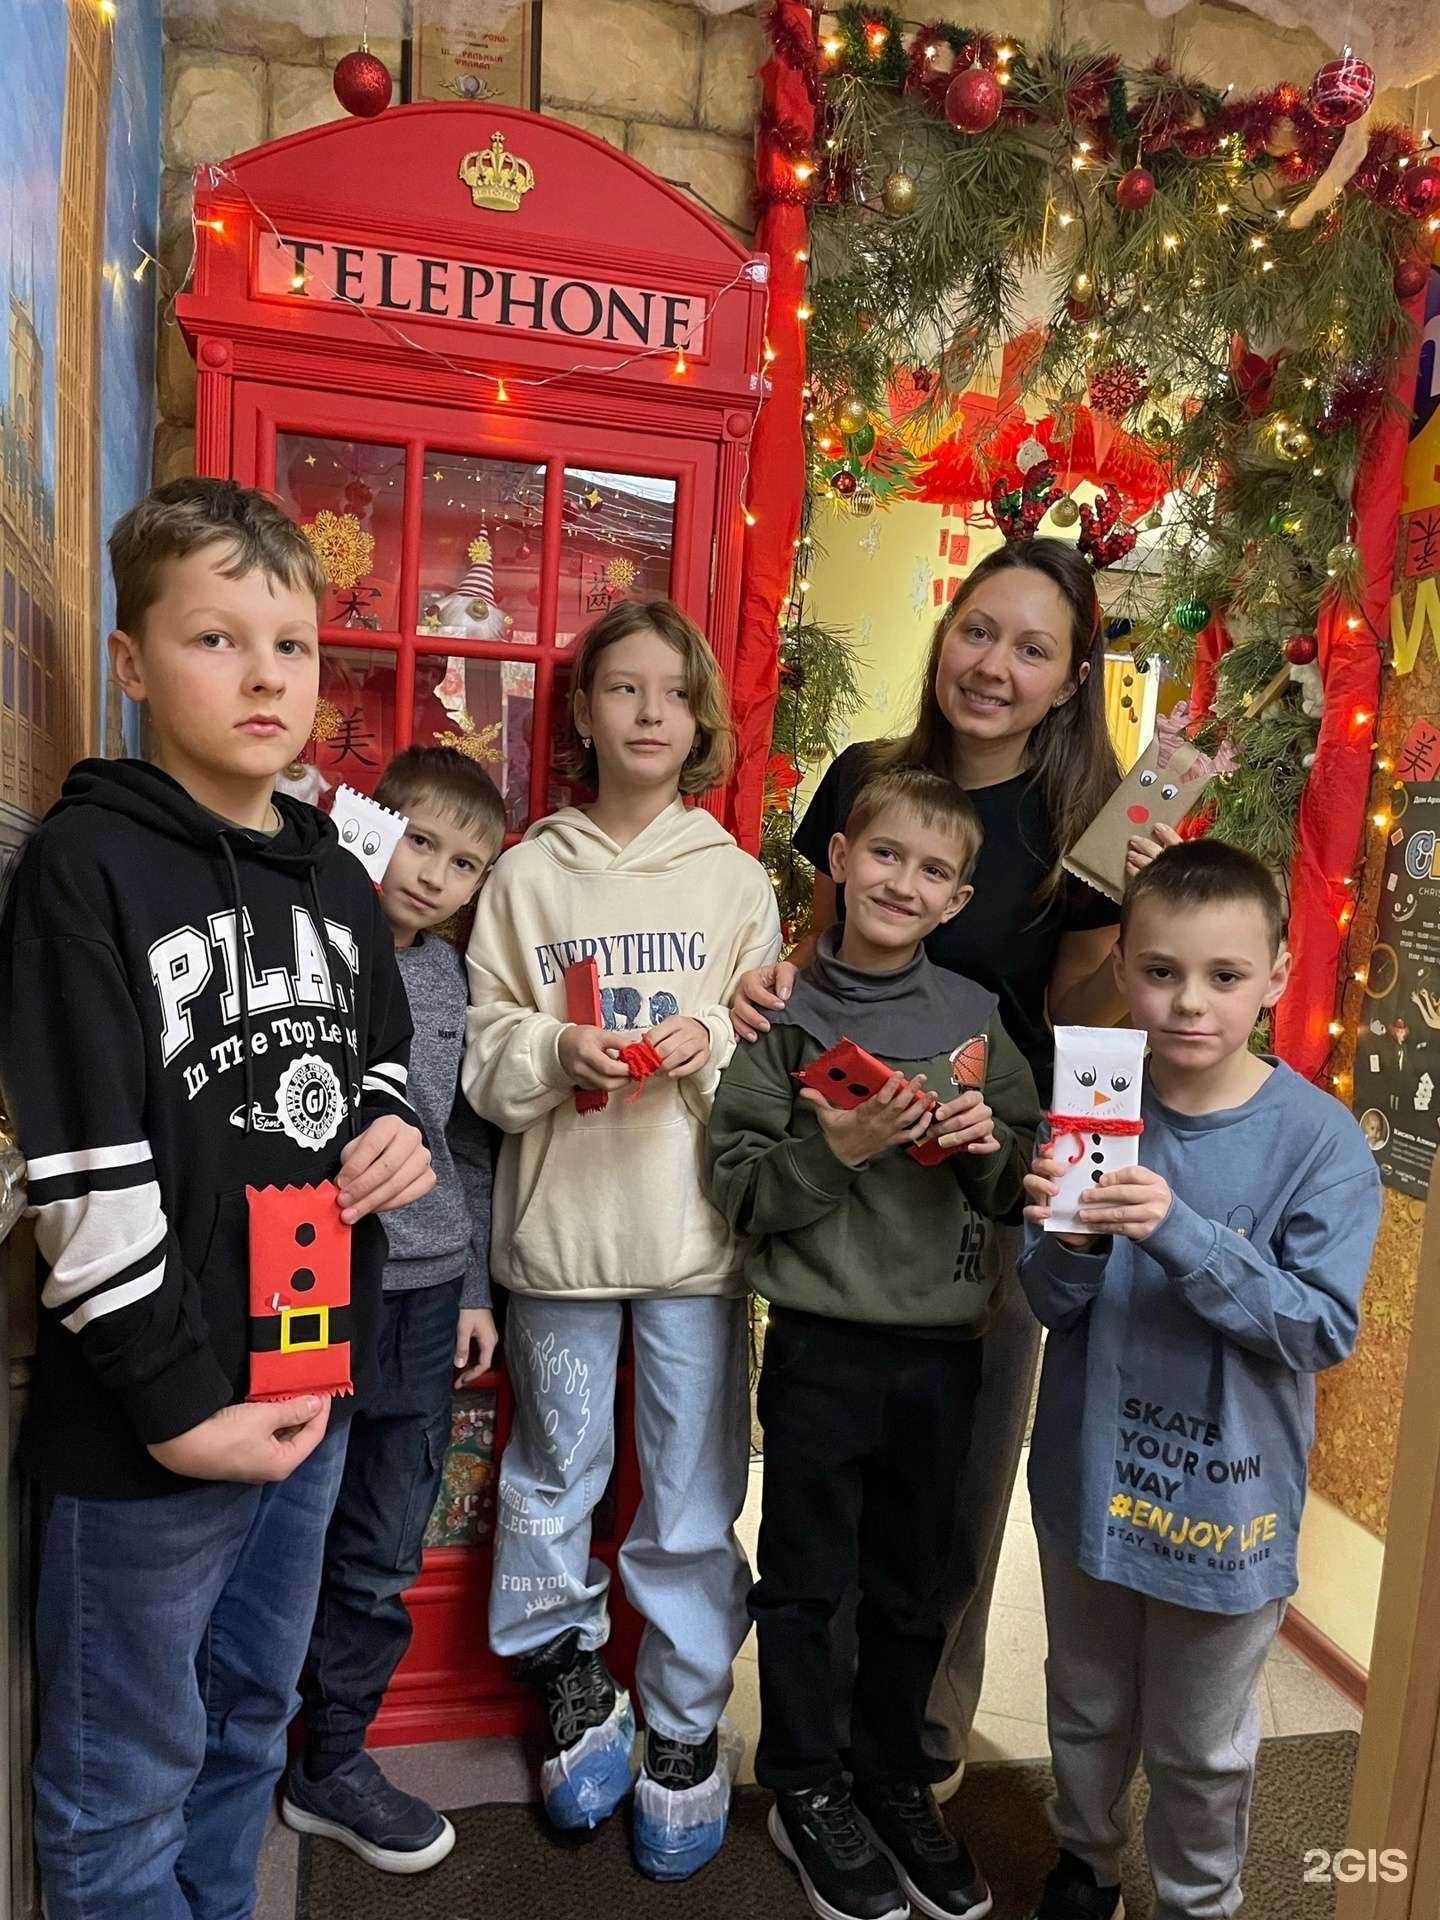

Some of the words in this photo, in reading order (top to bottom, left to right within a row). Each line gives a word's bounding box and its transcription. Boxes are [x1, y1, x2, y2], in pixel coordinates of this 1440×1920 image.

[276, 239, 691, 350] TELEPHONE
[326, 706, 380, 766] 美
[181, 1061, 210, 1101] In
[211, 1031, 269, 1074] The
[271, 1017, 315, 1048] Top
[1122, 1398, 1222, 1447] SKATE
[1115, 1459, 1182, 1503] WAY
[1119, 1427, 1200, 1477] YOUR
[1206, 1454, 1262, 1485] OWN
[501, 1514, 565, 1537] ECTION
[1107, 1525, 1145, 1547] STAY
[1152, 1542, 1197, 1564] TRUE
[1207, 1553, 1246, 1571] RIDE
[1108, 1493, 1234, 1553] #ENJOY
[501, 1574, 532, 1592] FOR
[536, 1572, 568, 1591] YOU
